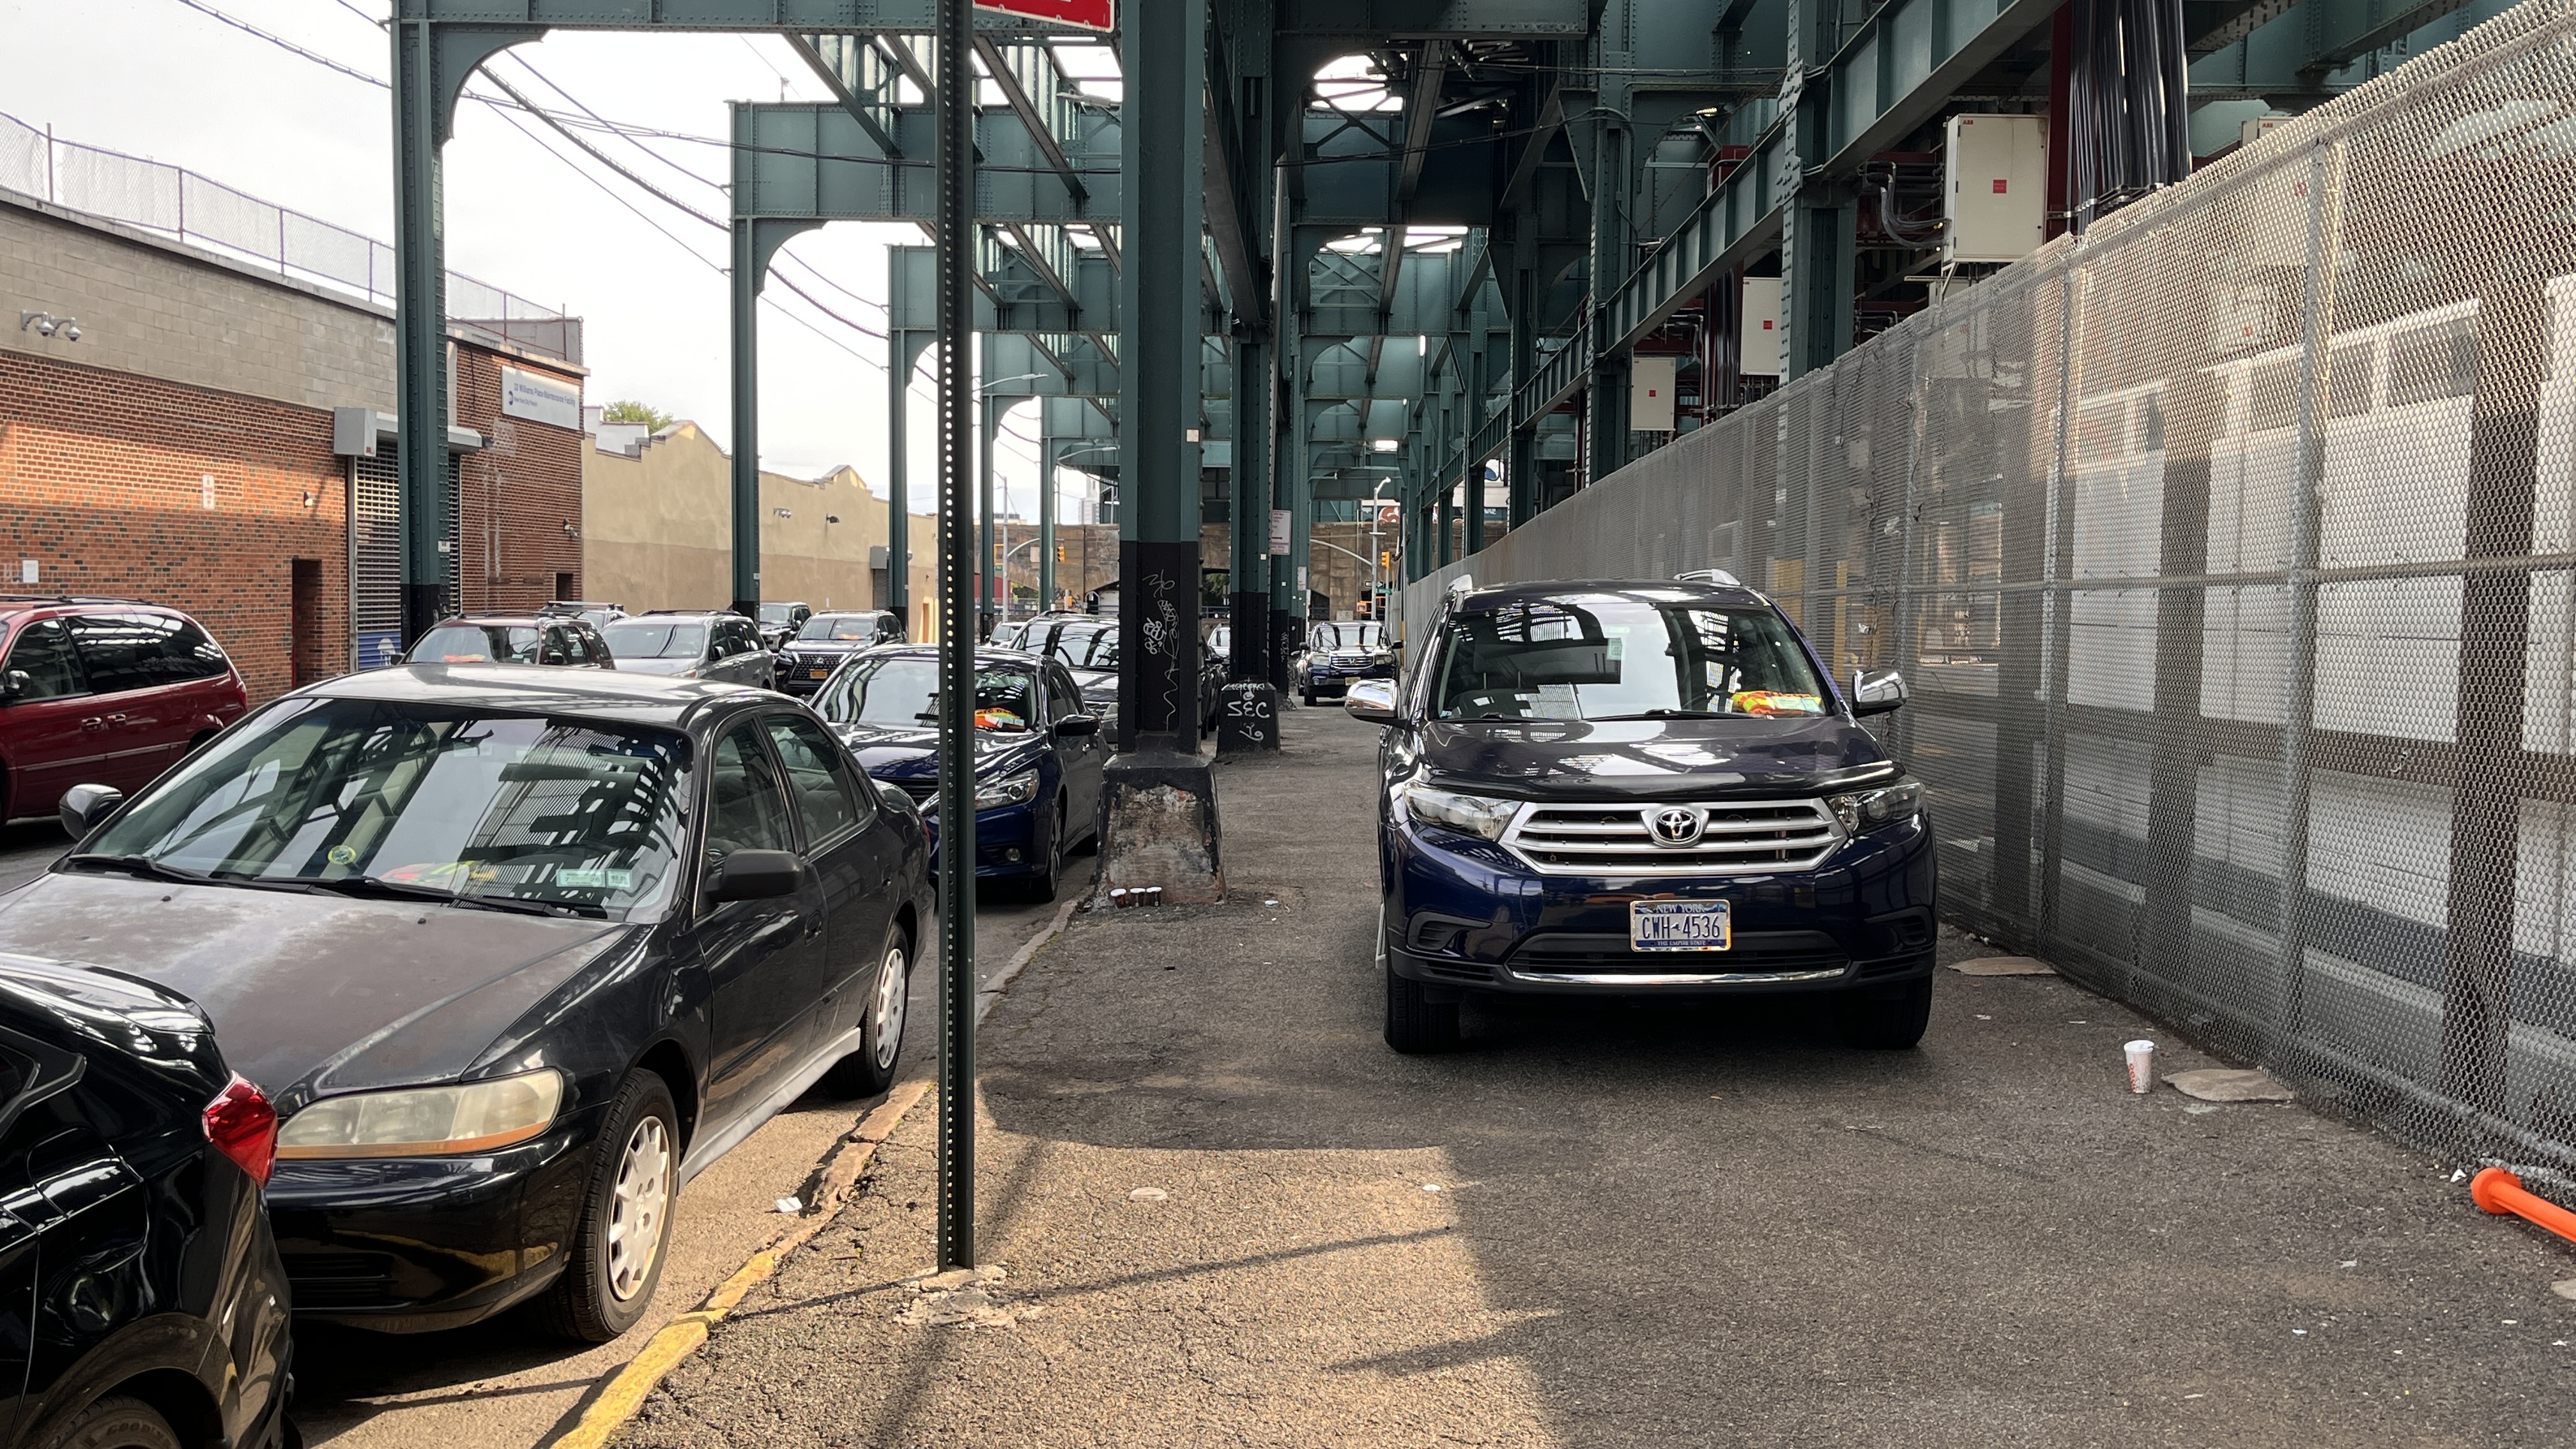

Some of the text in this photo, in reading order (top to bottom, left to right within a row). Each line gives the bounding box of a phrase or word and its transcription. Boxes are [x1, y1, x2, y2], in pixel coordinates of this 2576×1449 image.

[1655, 904, 1705, 914] NEW YORK
[1642, 914, 1720, 939] CWH 4536
